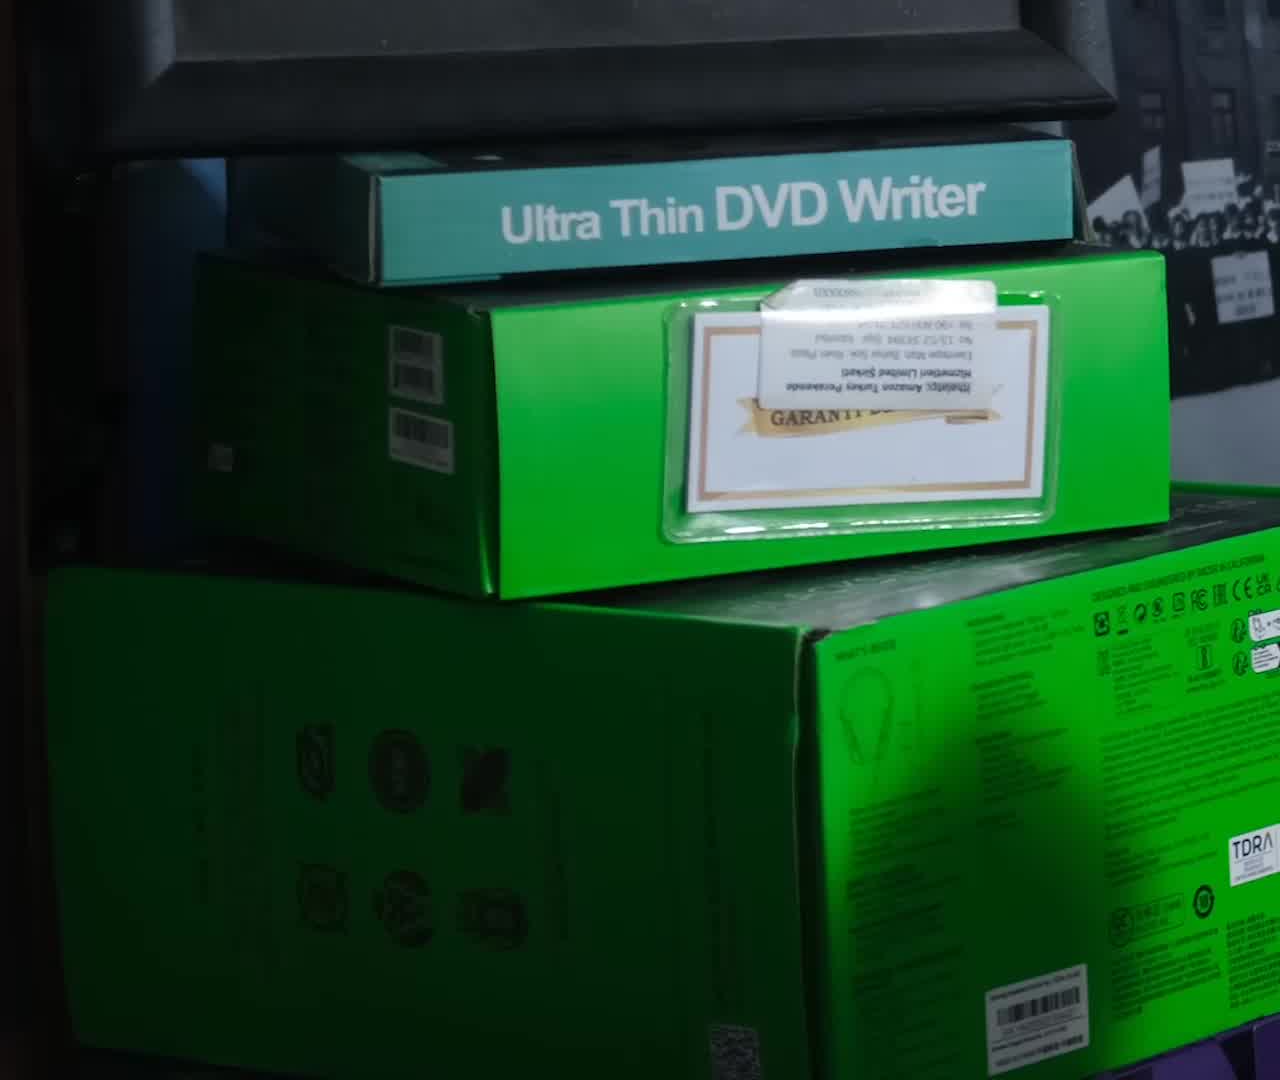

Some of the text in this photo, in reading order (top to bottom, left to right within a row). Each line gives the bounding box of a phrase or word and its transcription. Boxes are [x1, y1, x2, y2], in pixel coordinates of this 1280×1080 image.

[501, 174, 987, 245] Ultra Thin DVD Writer
[1232, 831, 1273, 859] TDRA
